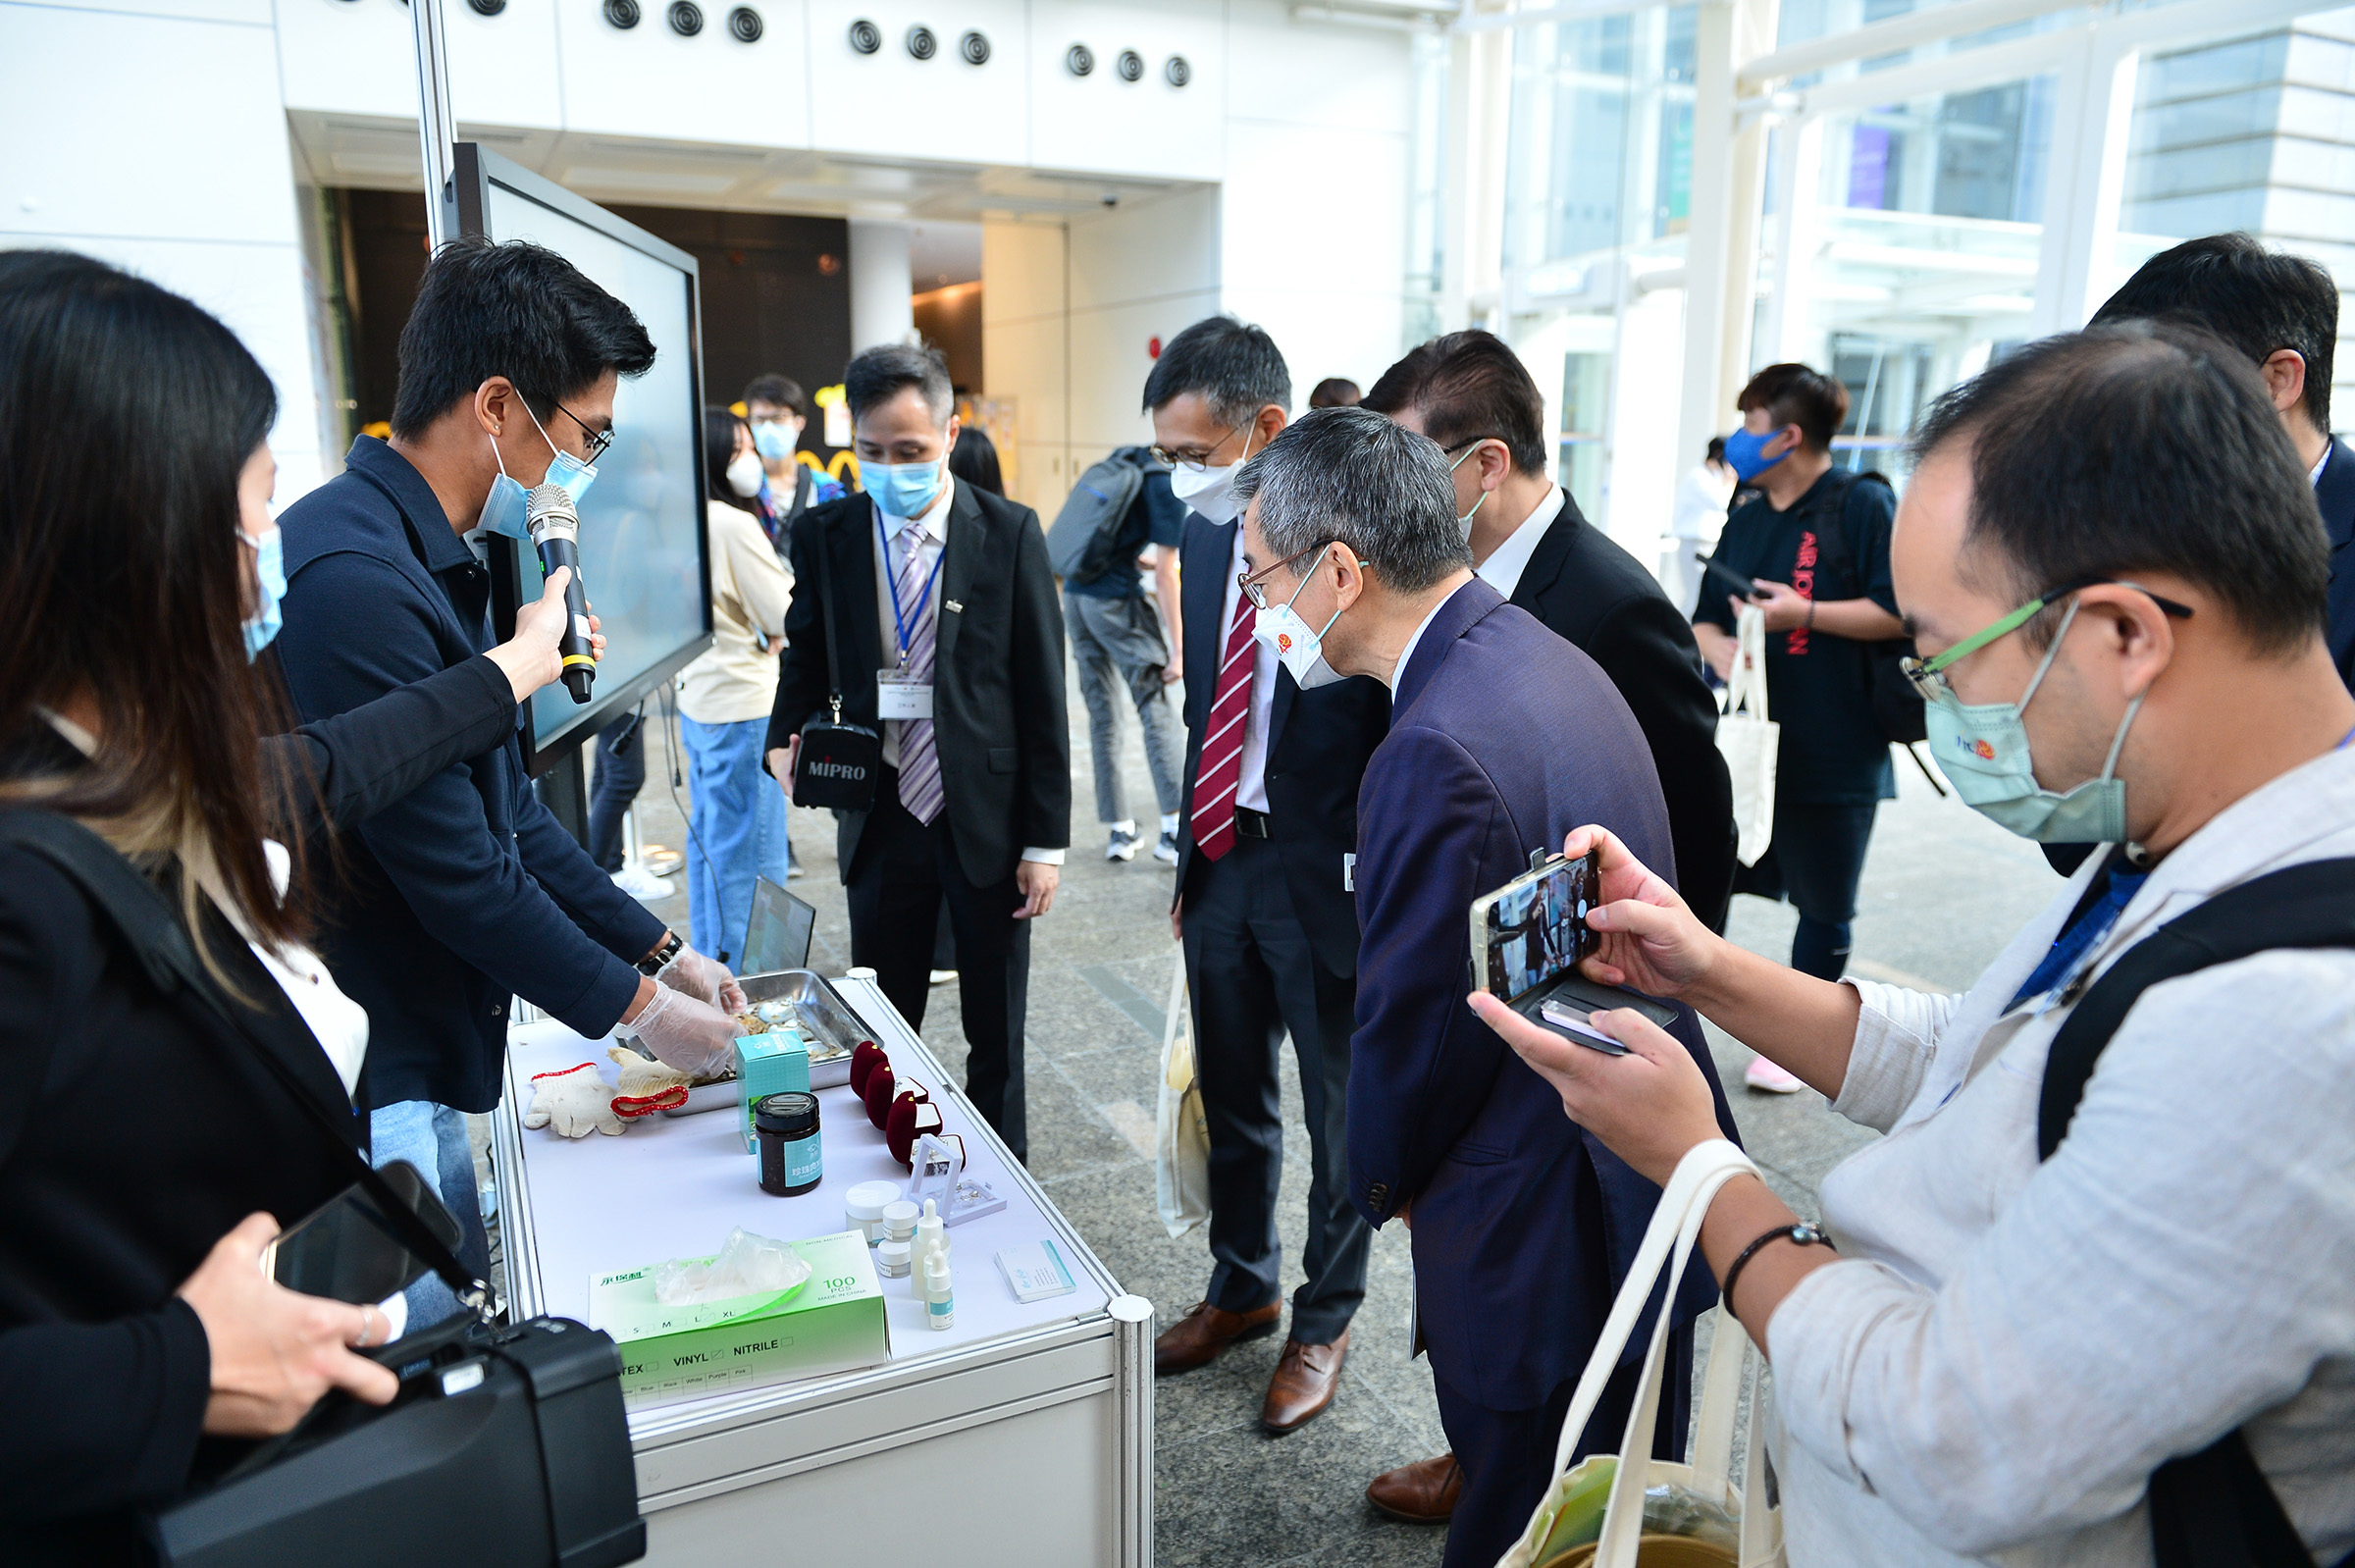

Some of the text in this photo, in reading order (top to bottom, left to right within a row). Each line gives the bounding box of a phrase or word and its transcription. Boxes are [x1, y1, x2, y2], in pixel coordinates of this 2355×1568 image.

[1786, 569, 1814, 655] JOAN
[806, 1233, 854, 1246] NON-MEDICAL
[823, 1276, 856, 1290] 100
[830, 1285, 852, 1294] PCS
[817, 1292, 837, 1302] MADE
[846, 1288, 866, 1297] CHINA
[619, 1339, 778, 1377] TEX VINYL NITRILE
[686, 1376, 704, 1385] White
[707, 1371, 727, 1381] Purple
